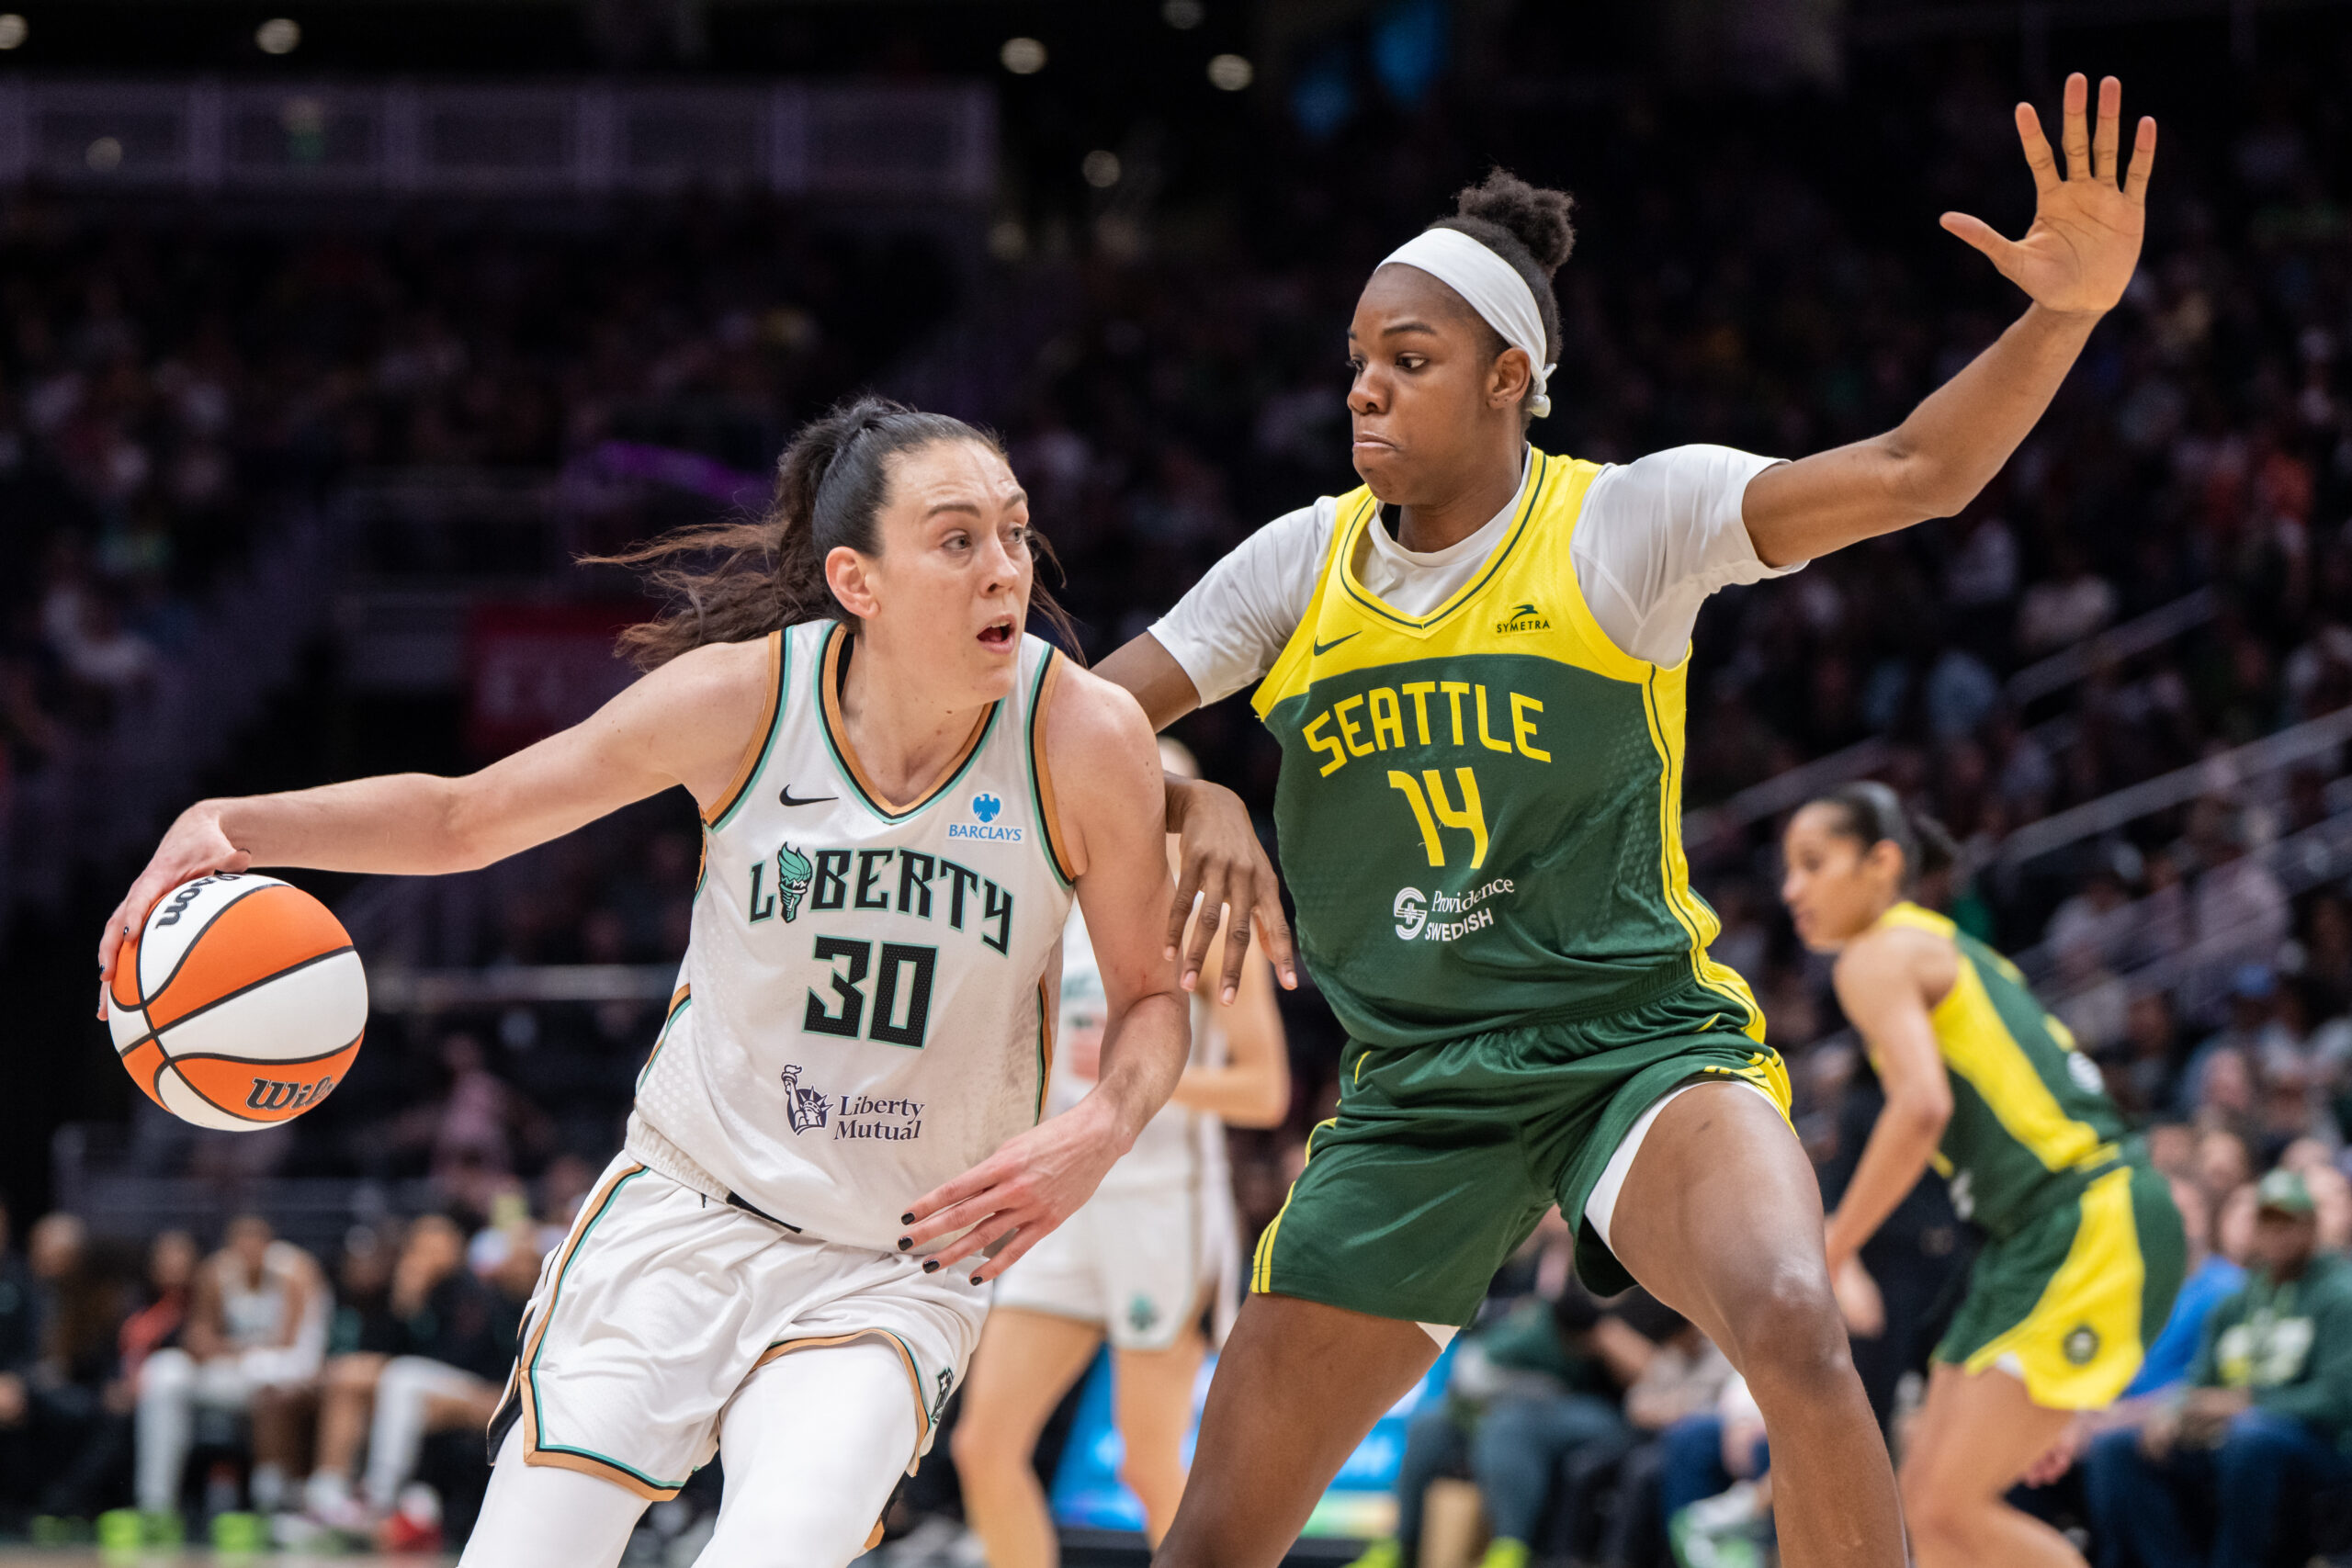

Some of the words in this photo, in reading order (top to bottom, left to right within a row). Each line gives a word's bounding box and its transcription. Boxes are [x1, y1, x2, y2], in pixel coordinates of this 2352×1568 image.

[1497, 620, 1550, 633] SYMETRA
[1302, 681, 1551, 777] SEATTLE
[948, 824, 1023, 841] BARCLAYS
[1387, 767, 1488, 869] 14
[1431, 878, 1515, 913] Providence
[1425, 908, 1494, 942] SWEDISH
[801, 934, 940, 1049] 30
[837, 1096, 926, 1125] Liberty
[833, 1120, 922, 1141] Mutual
